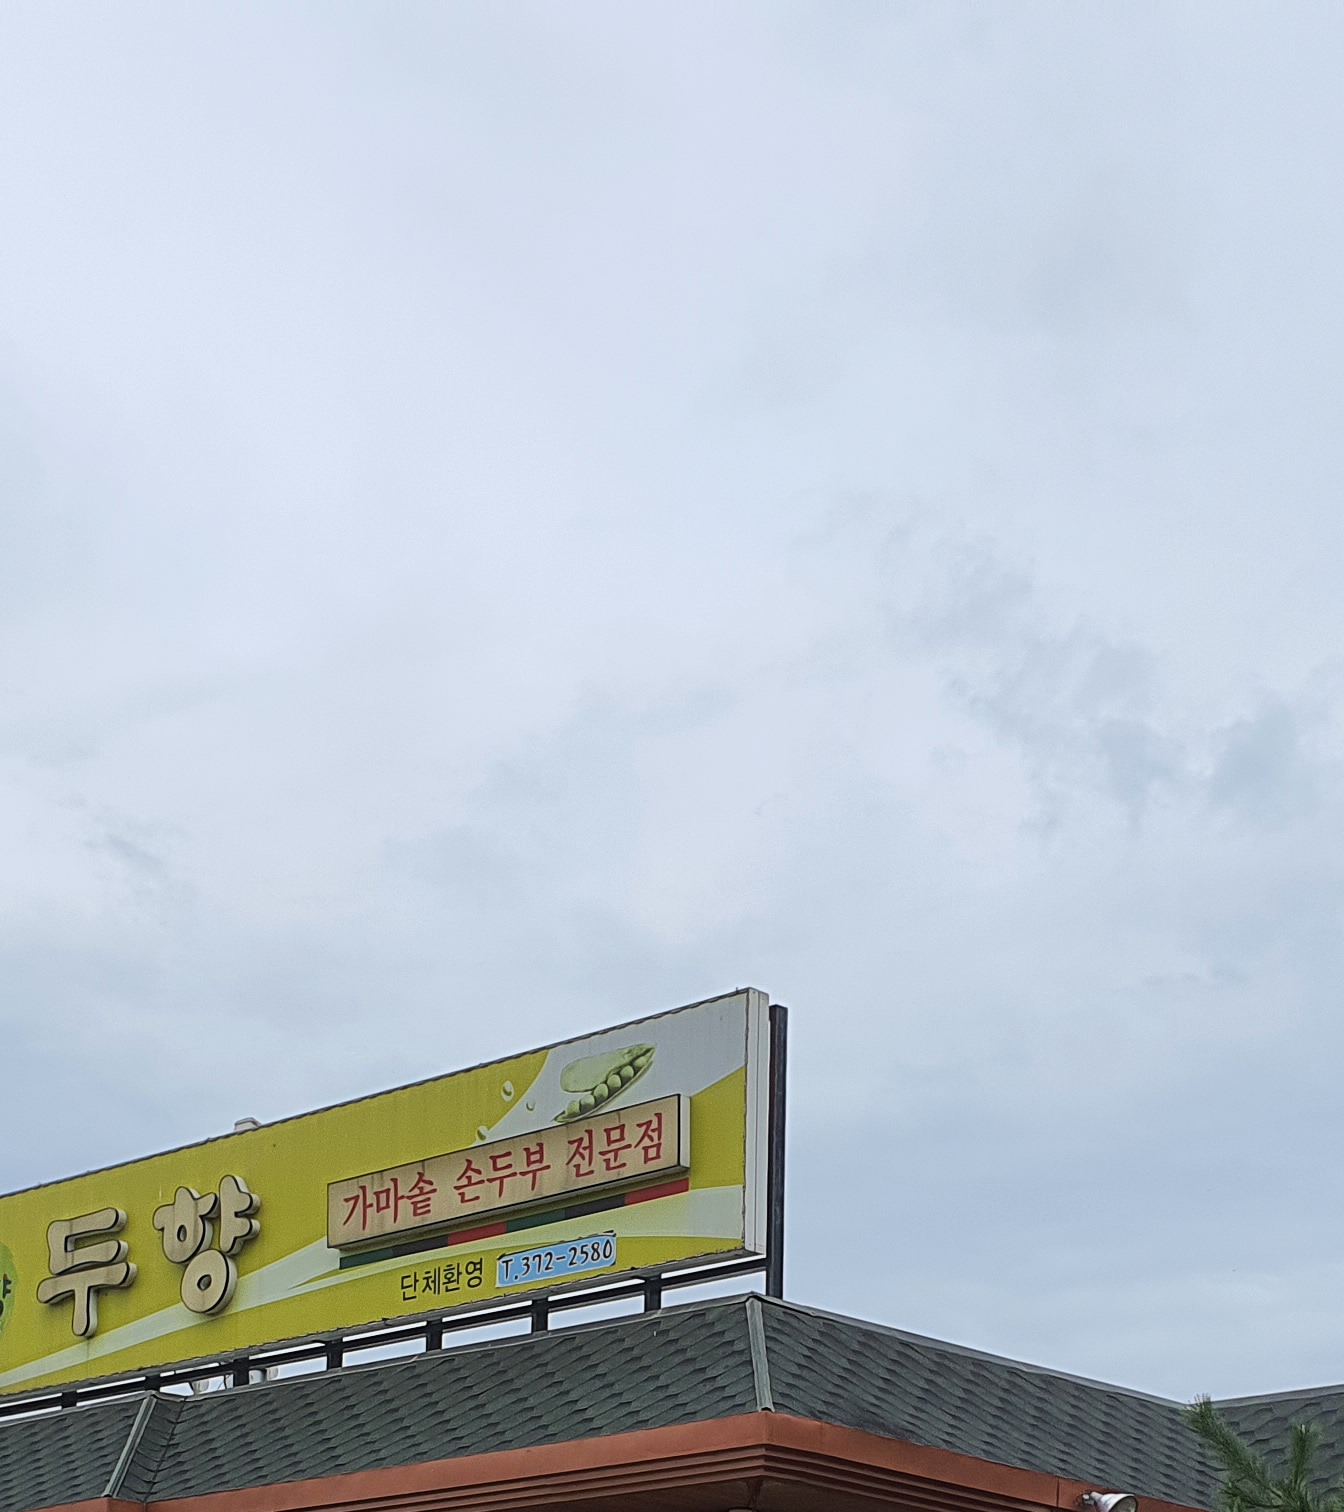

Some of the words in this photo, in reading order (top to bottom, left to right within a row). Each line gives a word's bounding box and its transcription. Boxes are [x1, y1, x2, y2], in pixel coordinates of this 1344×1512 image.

[343, 1172, 437, 1231] 가마솥
[453, 1143, 551, 1204] 손두부
[566, 1112, 663, 1179] 전문점
[37, 1174, 261, 1337] 두향
[400, 1257, 483, 1301] 단체환영
[502, 1239, 613, 1281] T.372-2580
